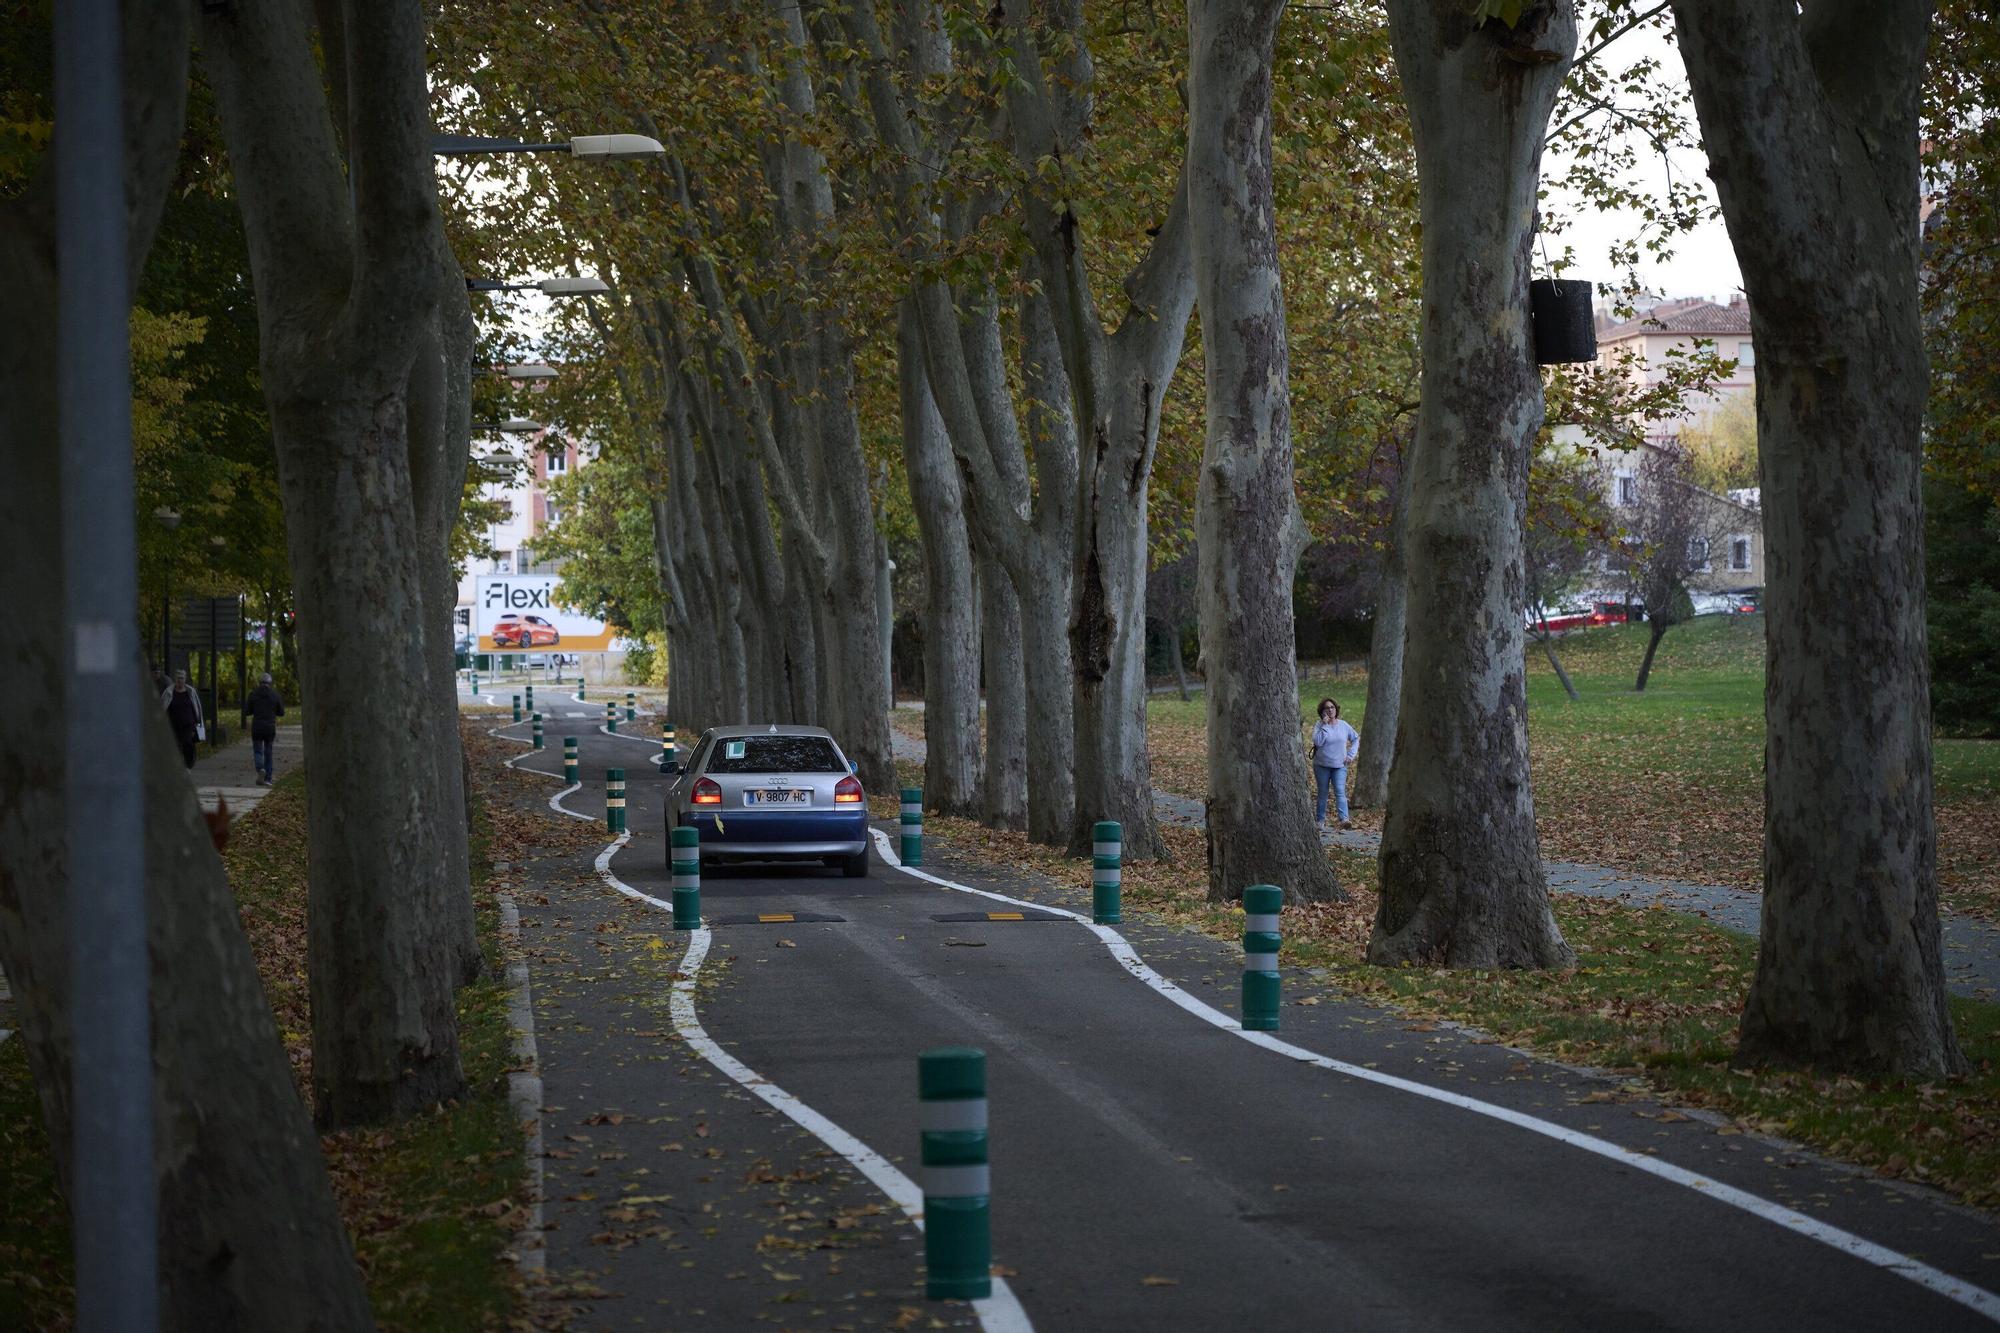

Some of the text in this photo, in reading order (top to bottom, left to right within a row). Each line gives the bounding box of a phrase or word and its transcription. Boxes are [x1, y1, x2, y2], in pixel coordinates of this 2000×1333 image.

[486, 582, 550, 608] Flexi
[729, 743, 742, 757] L
[766, 792, 790, 802] 9807
[793, 792, 806, 802] HC
